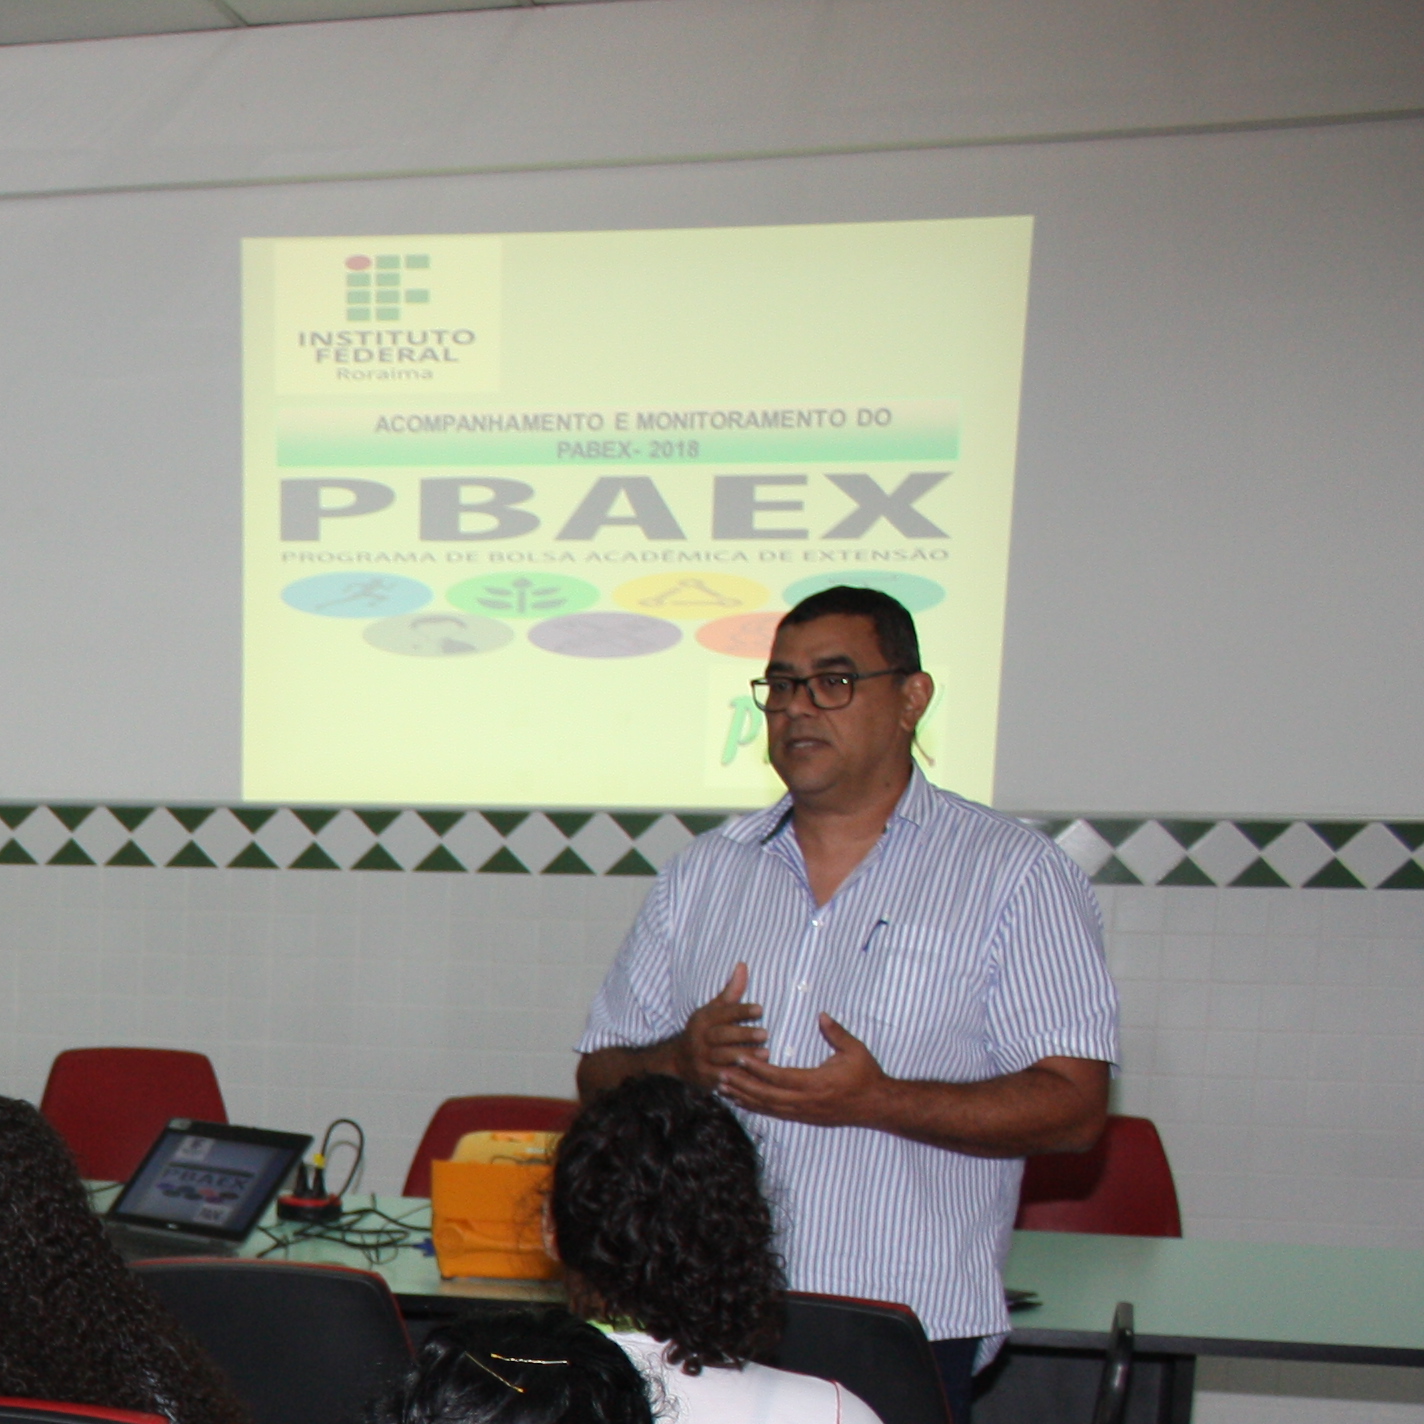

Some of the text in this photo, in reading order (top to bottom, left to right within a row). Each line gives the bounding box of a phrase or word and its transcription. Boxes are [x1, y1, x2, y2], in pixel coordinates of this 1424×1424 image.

[299, 328, 476, 346] INSTITUTO
[316, 347, 459, 363] FEDERAL
[337, 367, 433, 381] Roraima
[375, 407, 893, 434] ACOMPANHAMENTO E MONITORAMENTO DO
[557, 439, 700, 460] PABEX- 2018
[280, 472, 953, 541] PBAEX
[282, 547, 950, 564] PROGRAMA DE BOLSA ACADÊMICA DE EXTENSÃO
